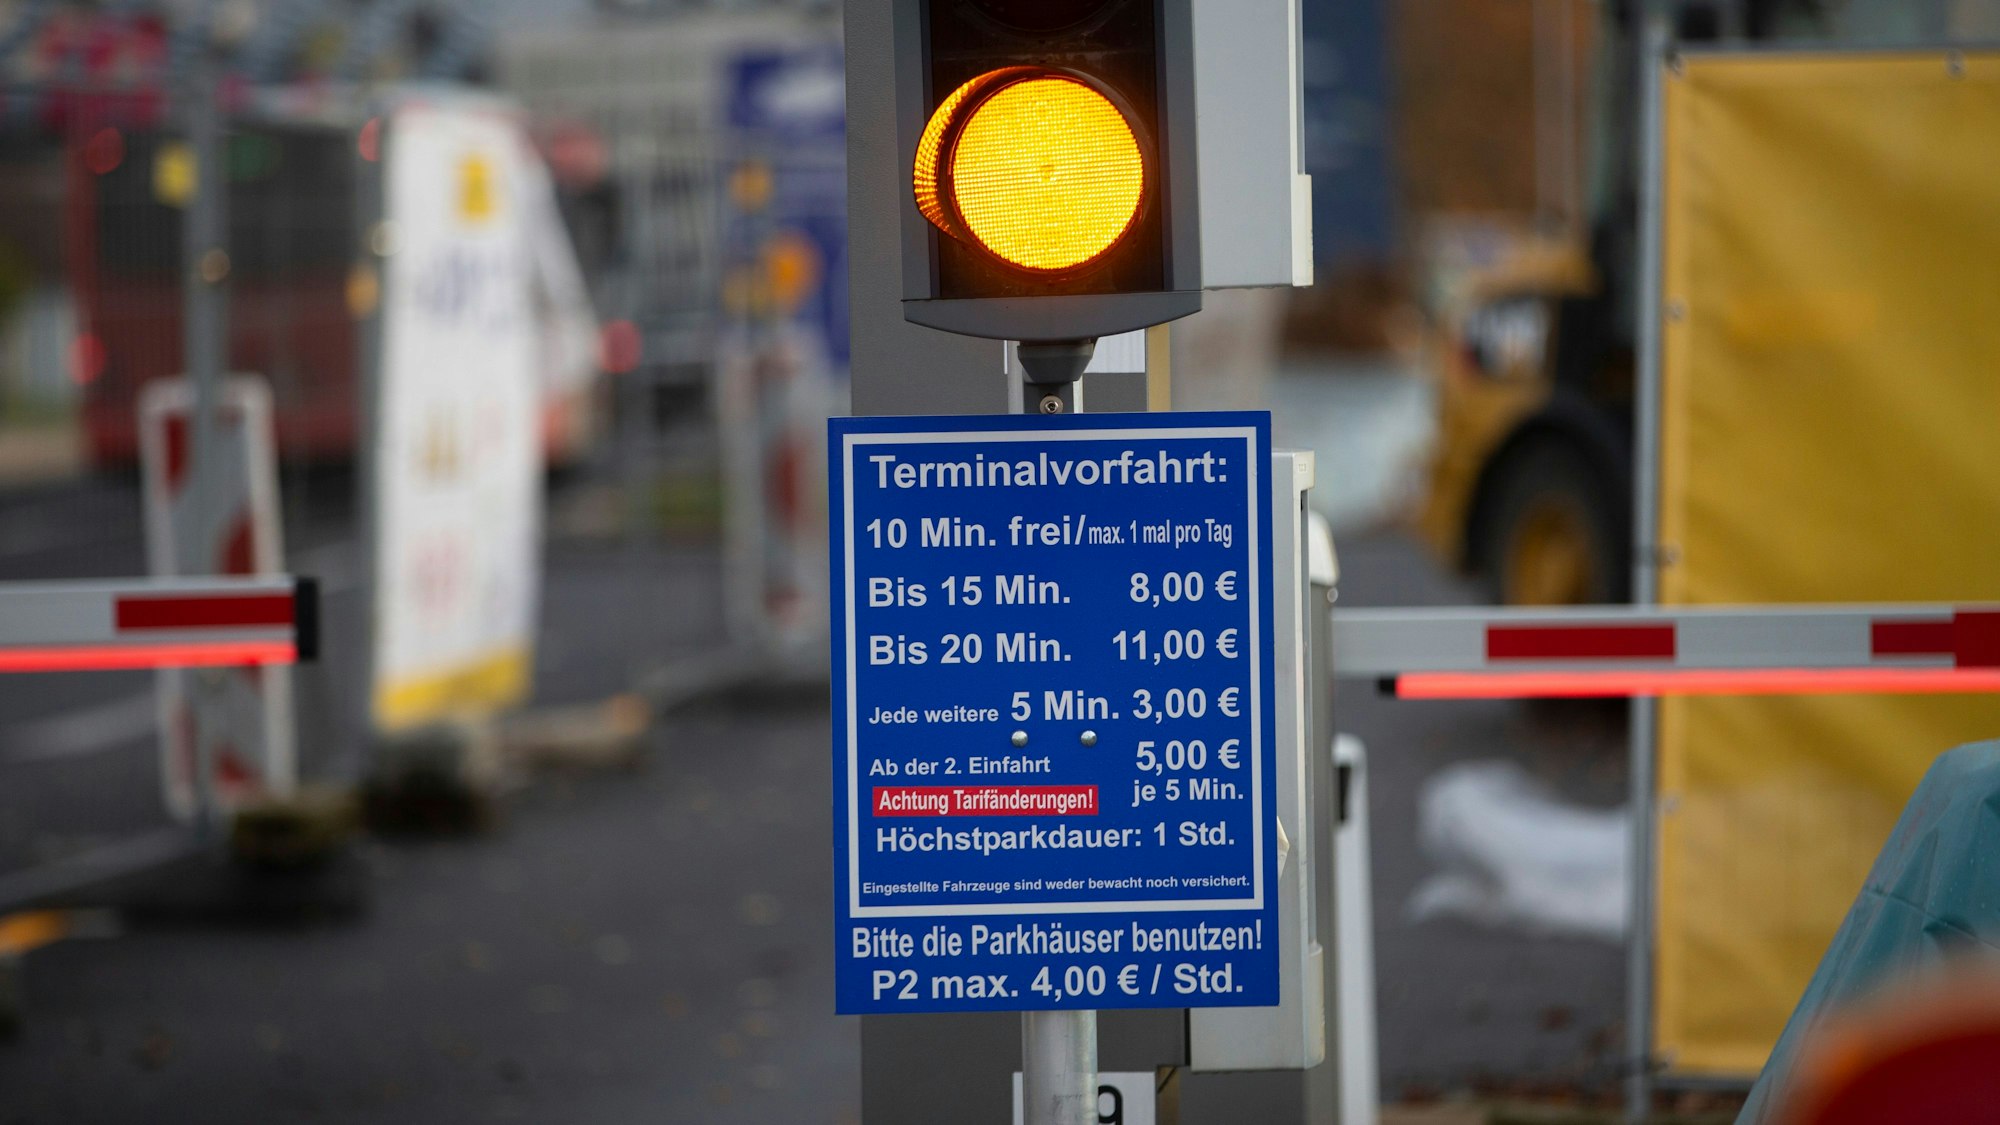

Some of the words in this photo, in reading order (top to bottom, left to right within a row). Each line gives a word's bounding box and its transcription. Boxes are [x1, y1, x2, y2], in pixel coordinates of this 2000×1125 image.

[868, 450, 1227, 489] Terminalvorfahrt:
[866, 518, 907, 549] 10
[921, 516, 997, 548] Min.
[1088, 525, 1125, 545] max.
[1130, 520, 1137, 544] 1
[1143, 519, 1170, 543] mal
[1175, 525, 1201, 549] pro
[1204, 518, 1232, 548] Tag
[869, 577, 927, 607] Bis
[940, 575, 982, 606] 15
[995, 574, 1071, 605] Min.
[1130, 571, 1204, 608] 8,00
[1215, 570, 1237, 601] €
[870, 635, 928, 665] Bis
[940, 633, 983, 664] 20
[996, 632, 1071, 663] Min.
[1112, 629, 1205, 666] 11,00
[1215, 628, 1238, 659] €
[869, 706, 918, 724] Jede
[924, 705, 999, 723] weitere
[1011, 691, 1031, 722] 5
[1044, 690, 1119, 721] Min.
[1133, 688, 1207, 724] 3,00
[1217, 687, 1240, 718] €
[869, 758, 899, 776] Ab
[904, 758, 939, 776] der
[944, 757, 962, 775] 2.
[969, 755, 1051, 774] Einfahrt
[1136, 739, 1207, 776] 5,00
[1218, 738, 1240, 769] €
[879, 790, 949, 815] Achtung
[953, 788, 1093, 815] Tarifänderungen!
[1131, 779, 1156, 808] je
[1165, 779, 1180, 801] 5
[1189, 778, 1244, 800] Min.
[877, 824, 1141, 856] Höchstparkdauer:
[1154, 822, 1165, 846] 1
[1179, 821, 1234, 846] Std.
[863, 881, 939, 896] Eingestellte
[943, 880, 1010, 894] Fahrzeuge
[1014, 879, 1042, 891] sind
[1045, 878, 1085, 890] weder
[1088, 877, 1142, 889] bewacht
[1146, 876, 1178, 888] noch
[1182, 875, 1250, 887] versichert.
[853, 925, 914, 958] Bitte
[922, 925, 962, 957] die
[971, 922, 1124, 955] Parkhäuser
[1132, 919, 1262, 952] benutzen!
[873, 969, 918, 1000] P2
[932, 975, 1018, 999] max.
[1031, 965, 1106, 1002] 4,00
[1117, 964, 1139, 995] €
[1150, 964, 1162, 994] /
[1173, 963, 1243, 994] Std.
